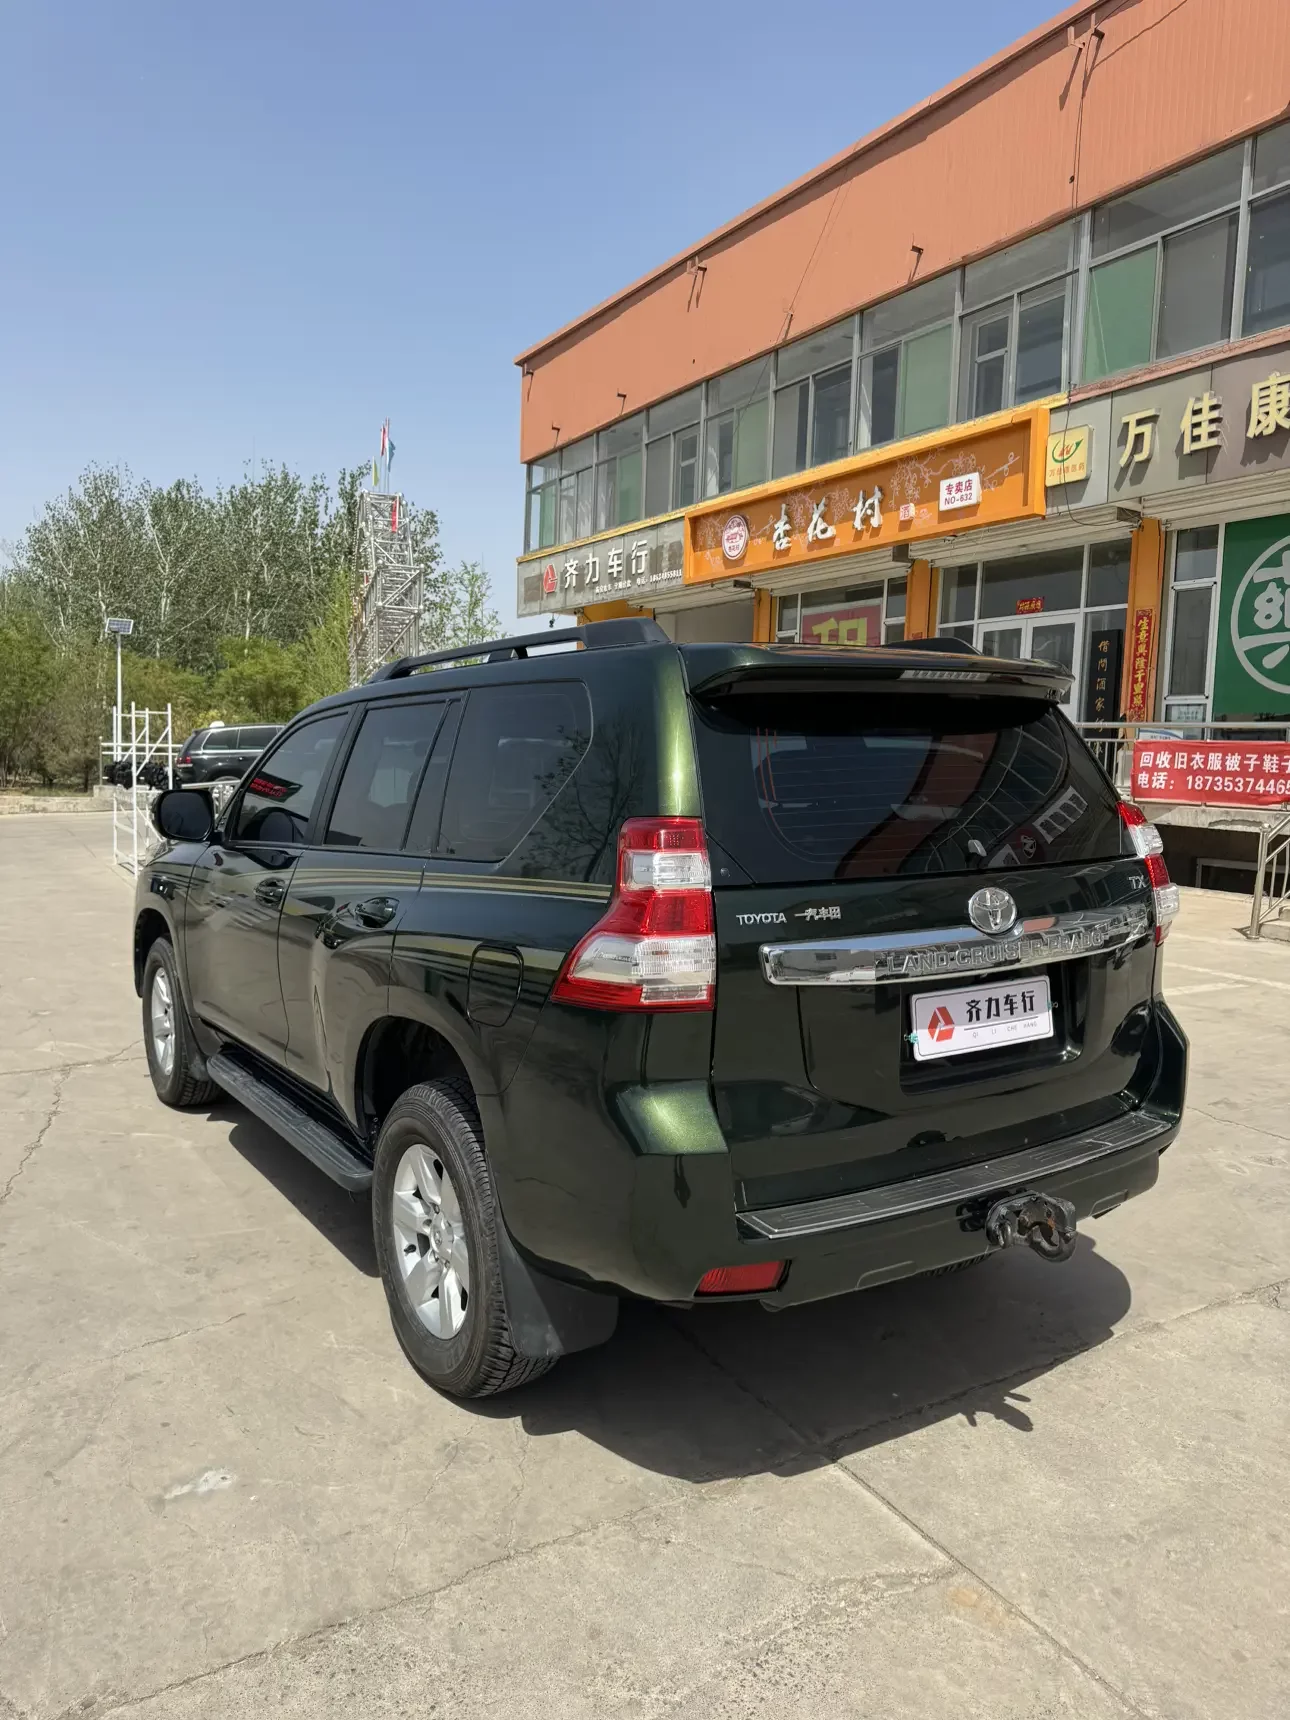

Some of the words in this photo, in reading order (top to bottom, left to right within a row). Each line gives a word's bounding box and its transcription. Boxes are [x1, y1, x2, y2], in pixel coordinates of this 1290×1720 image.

[1119, 371, 1290, 468] 万佳康
[945, 479, 973, 495] 专卖店
[563, 540, 649, 589] 齐力车行
[736, 912, 787, 926] TOYOTA
[887, 952, 951, 973] LAND
[956, 939, 1042, 966] CRUISER
[1047, 929, 1105, 953] PRADO
[965, 990, 1035, 1023] 齐力车行
